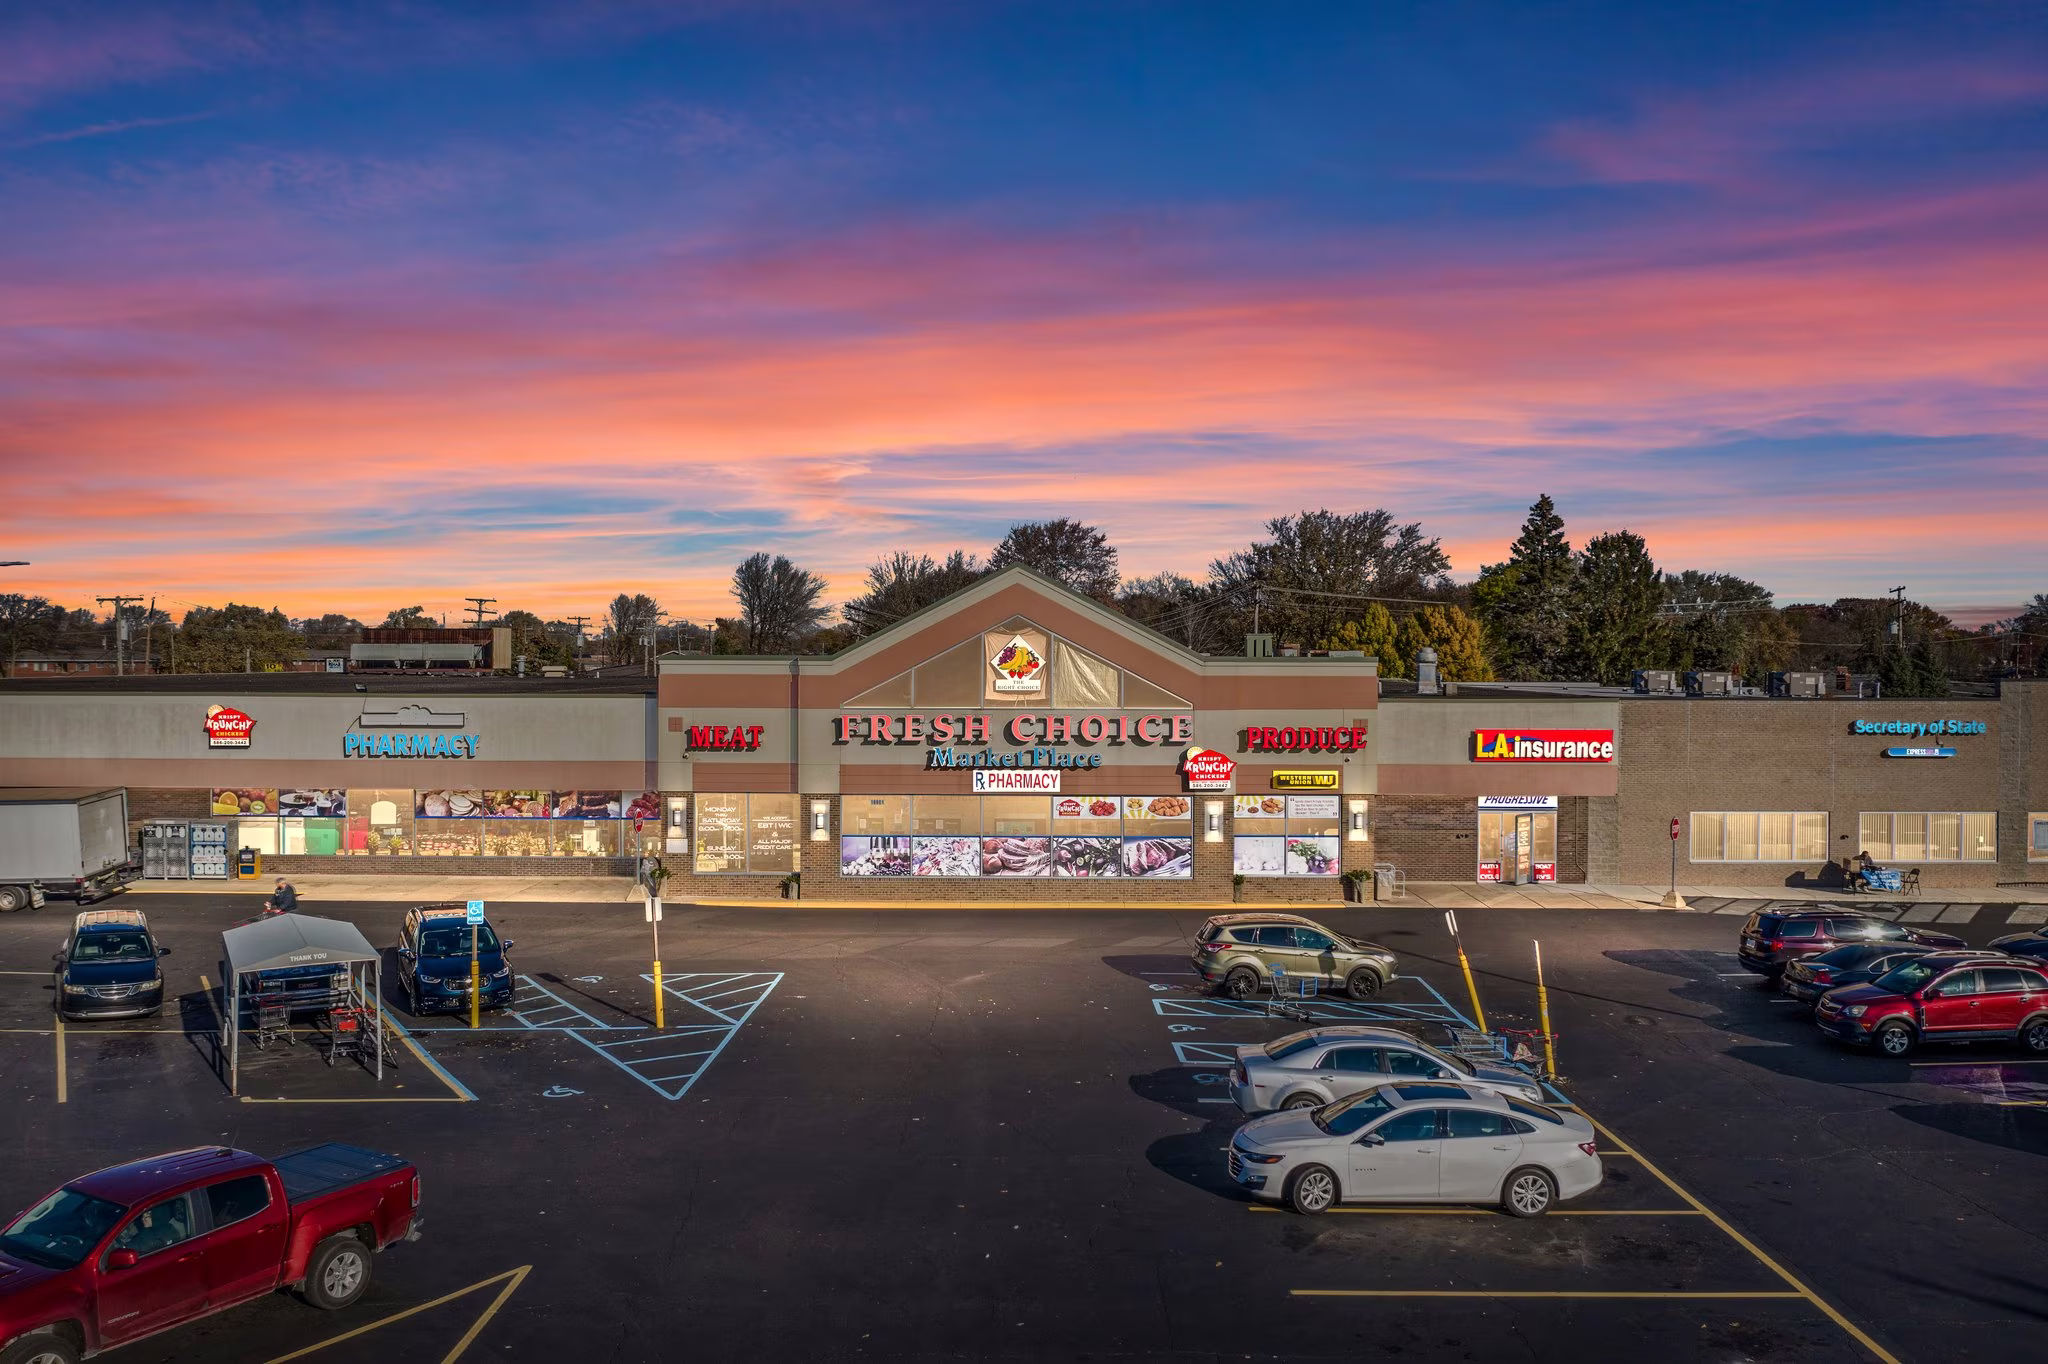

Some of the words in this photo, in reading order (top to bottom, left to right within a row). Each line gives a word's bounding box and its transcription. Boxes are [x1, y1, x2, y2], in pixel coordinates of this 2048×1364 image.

[206, 718, 253, 731] KRUNCHY
[838, 713, 992, 742] FRESH
[1011, 714, 1193, 743] CHOICE
[1855, 719, 1927, 736] Secretary
[1929, 719, 1945, 733] of
[1947, 719, 1987, 734] State
[344, 732, 480, 757] PHARMACY
[689, 725, 765, 748] MEAT
[1246, 726, 1368, 749] PRODUCE
[931, 746, 1024, 767] Market
[1031, 746, 1103, 767] Place
[1185, 761, 1235, 773] KRUNCHY
[988, 773, 1059, 789] PHARMACY
[1484, 796, 1549, 805] PROGRESSIVE
[289, 954, 313, 962] THANK
[313, 952, 328, 960] YOU
